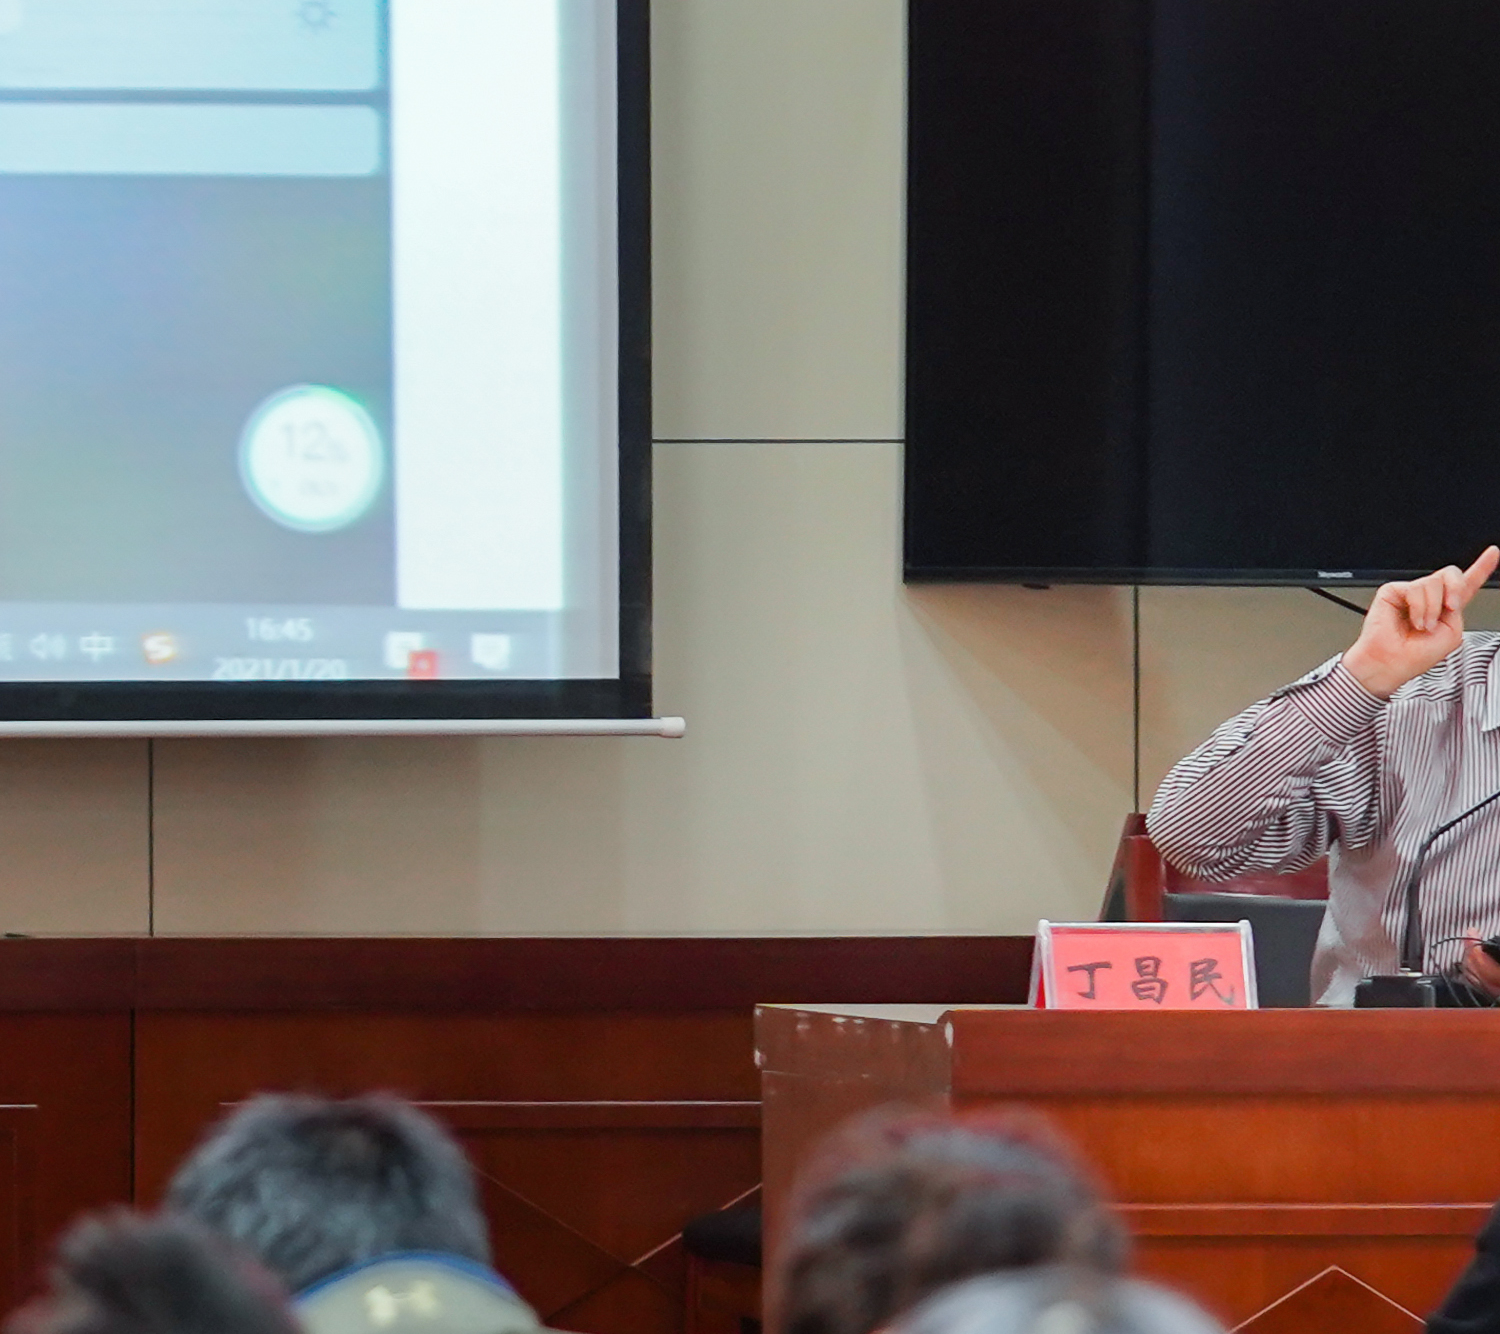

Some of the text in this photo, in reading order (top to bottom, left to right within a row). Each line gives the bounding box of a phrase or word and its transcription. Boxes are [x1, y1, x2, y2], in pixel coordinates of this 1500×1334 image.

[245, 618, 314, 643] 16:45
[1067, 955, 1236, 1005] 丁昌民
